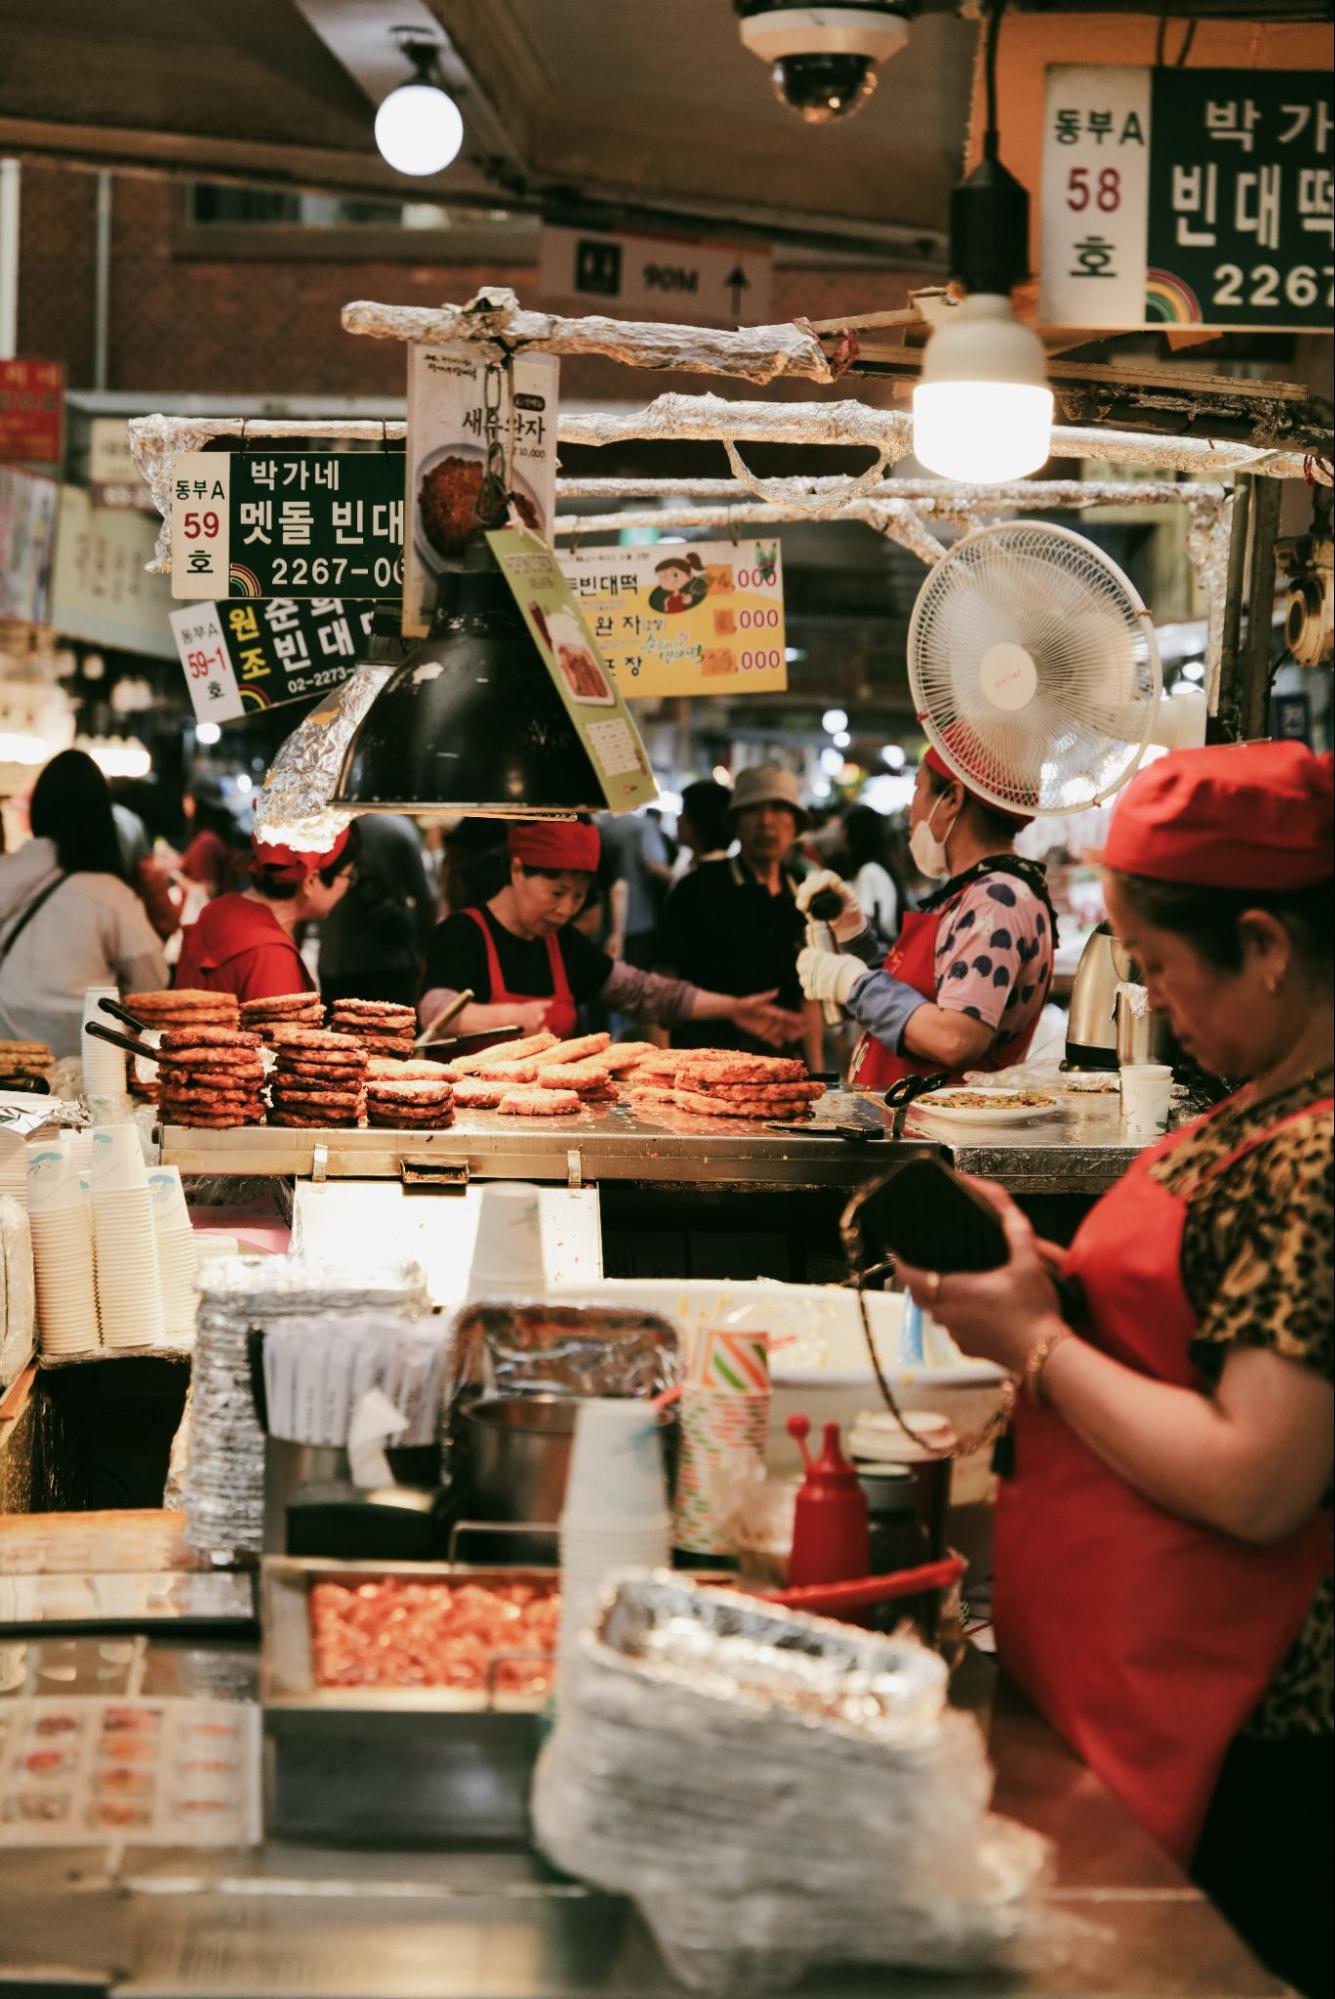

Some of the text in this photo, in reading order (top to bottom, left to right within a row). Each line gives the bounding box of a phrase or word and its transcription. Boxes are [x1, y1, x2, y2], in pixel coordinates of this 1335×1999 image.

[1055, 109, 1144, 146] 동부A
[1067, 168, 1121, 212] 58
[1069, 236, 1117, 278] 호
[643, 263, 698, 294] 90M
[175, 480, 225, 500] 동부A
[251, 459, 339, 491] 박가네
[184, 511, 220, 539] 59
[240, 499, 404, 546] 멧돌 빈대
[187, 550, 214, 574] 호
[229, 606, 271, 681] 원조
[188, 646, 226, 679] 59-1
